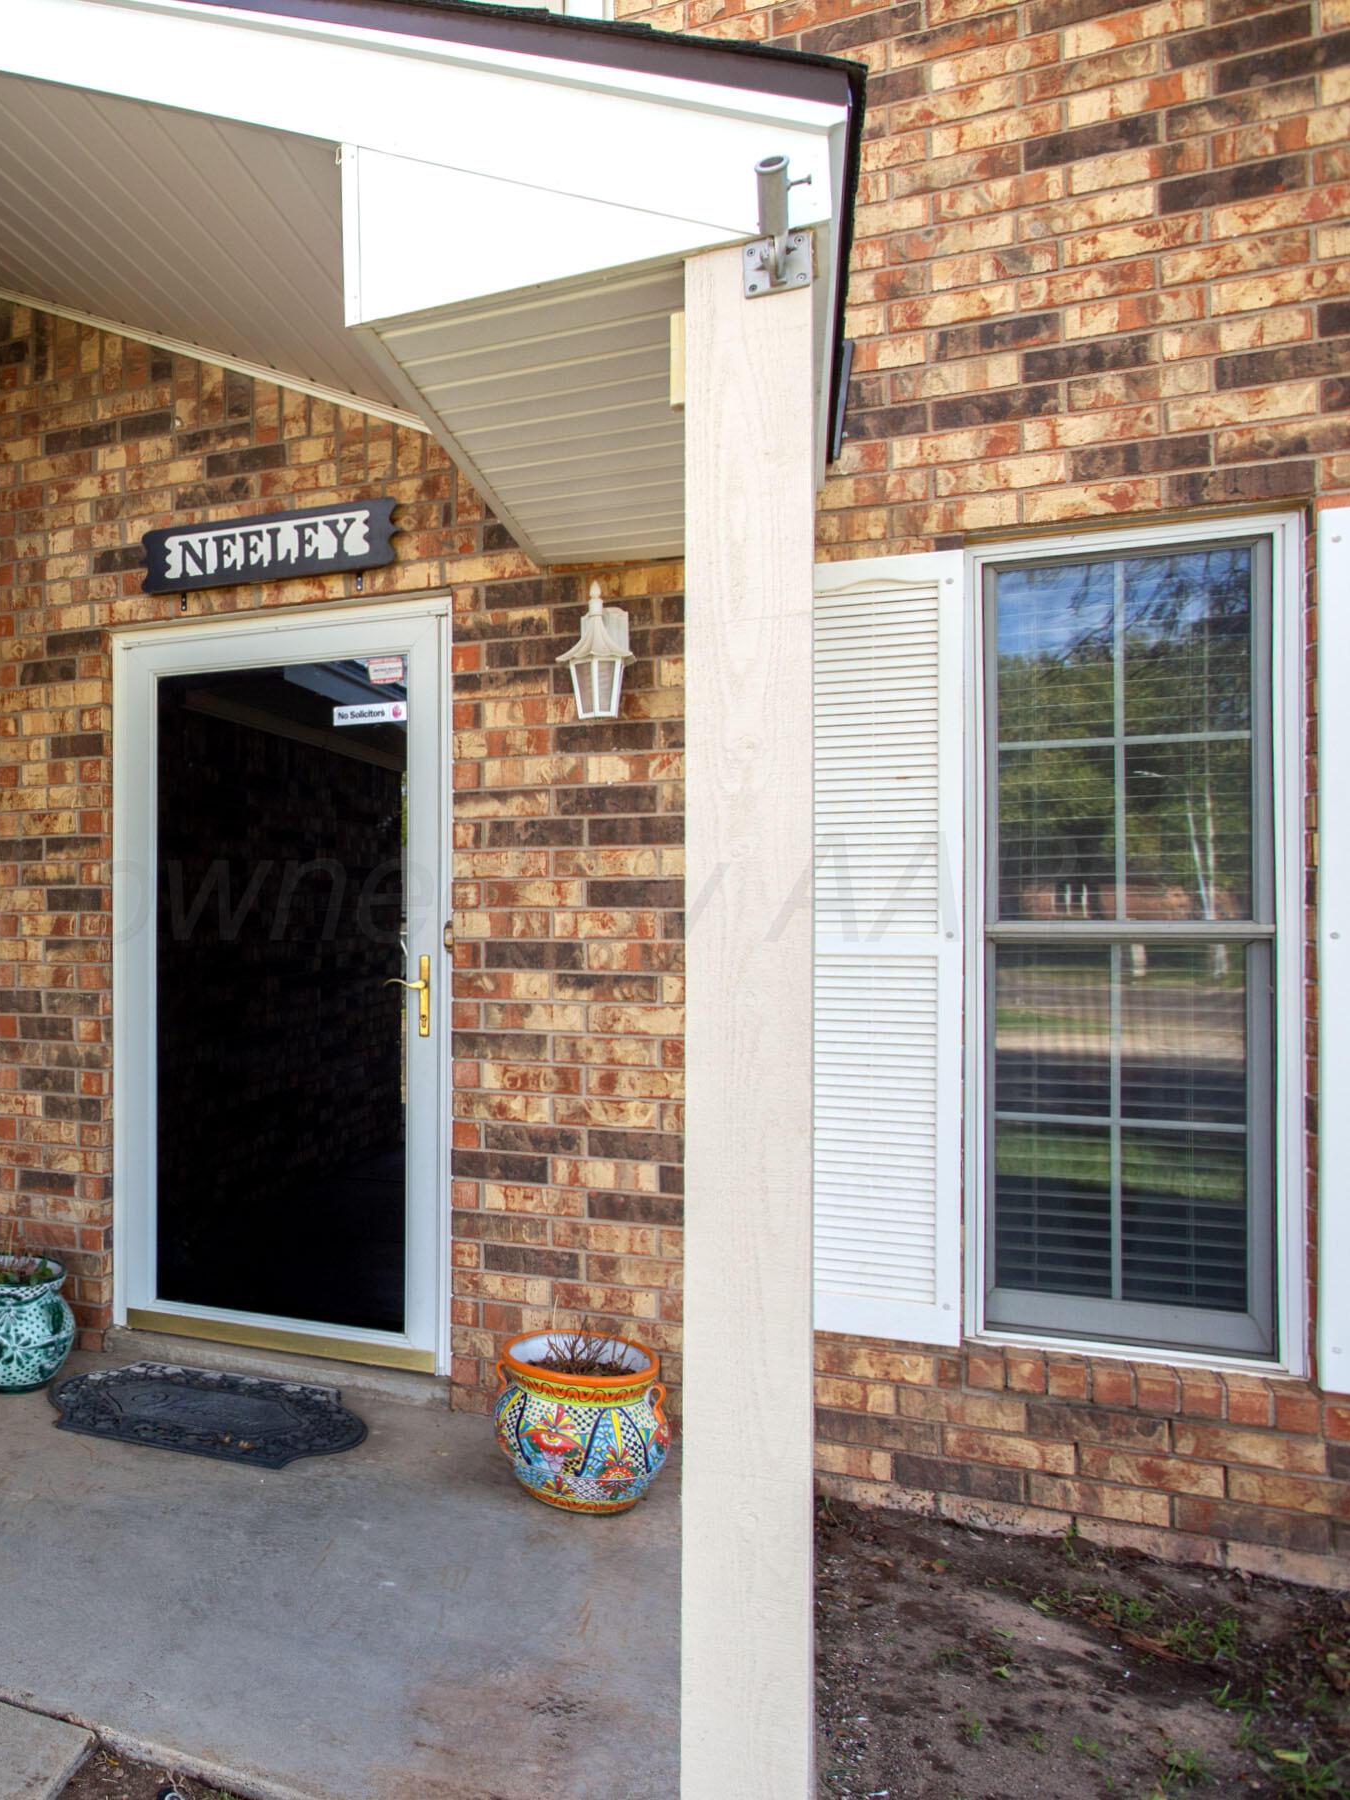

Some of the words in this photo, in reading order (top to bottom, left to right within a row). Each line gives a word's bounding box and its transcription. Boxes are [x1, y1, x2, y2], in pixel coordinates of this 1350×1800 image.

[178, 516, 357, 577] NEELEY
[338, 712, 349, 720] No
[350, 709, 386, 719] Solicitors
